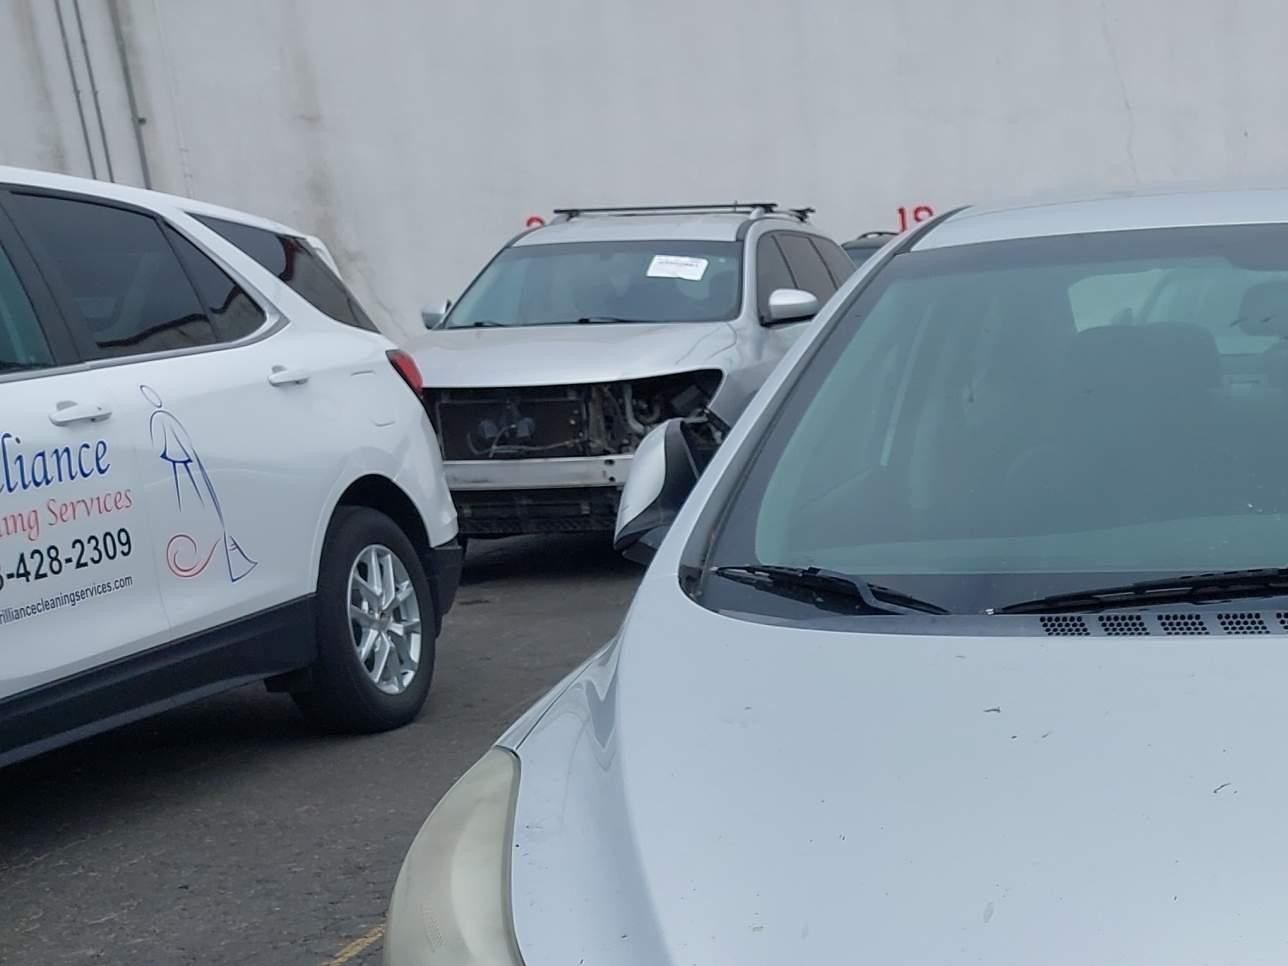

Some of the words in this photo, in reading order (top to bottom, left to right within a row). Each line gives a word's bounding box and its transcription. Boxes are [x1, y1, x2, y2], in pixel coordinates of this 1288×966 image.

[0, 433, 111, 494] liance
[0, 509, 40, 541] ing
[46, 488, 133, 526] Services
